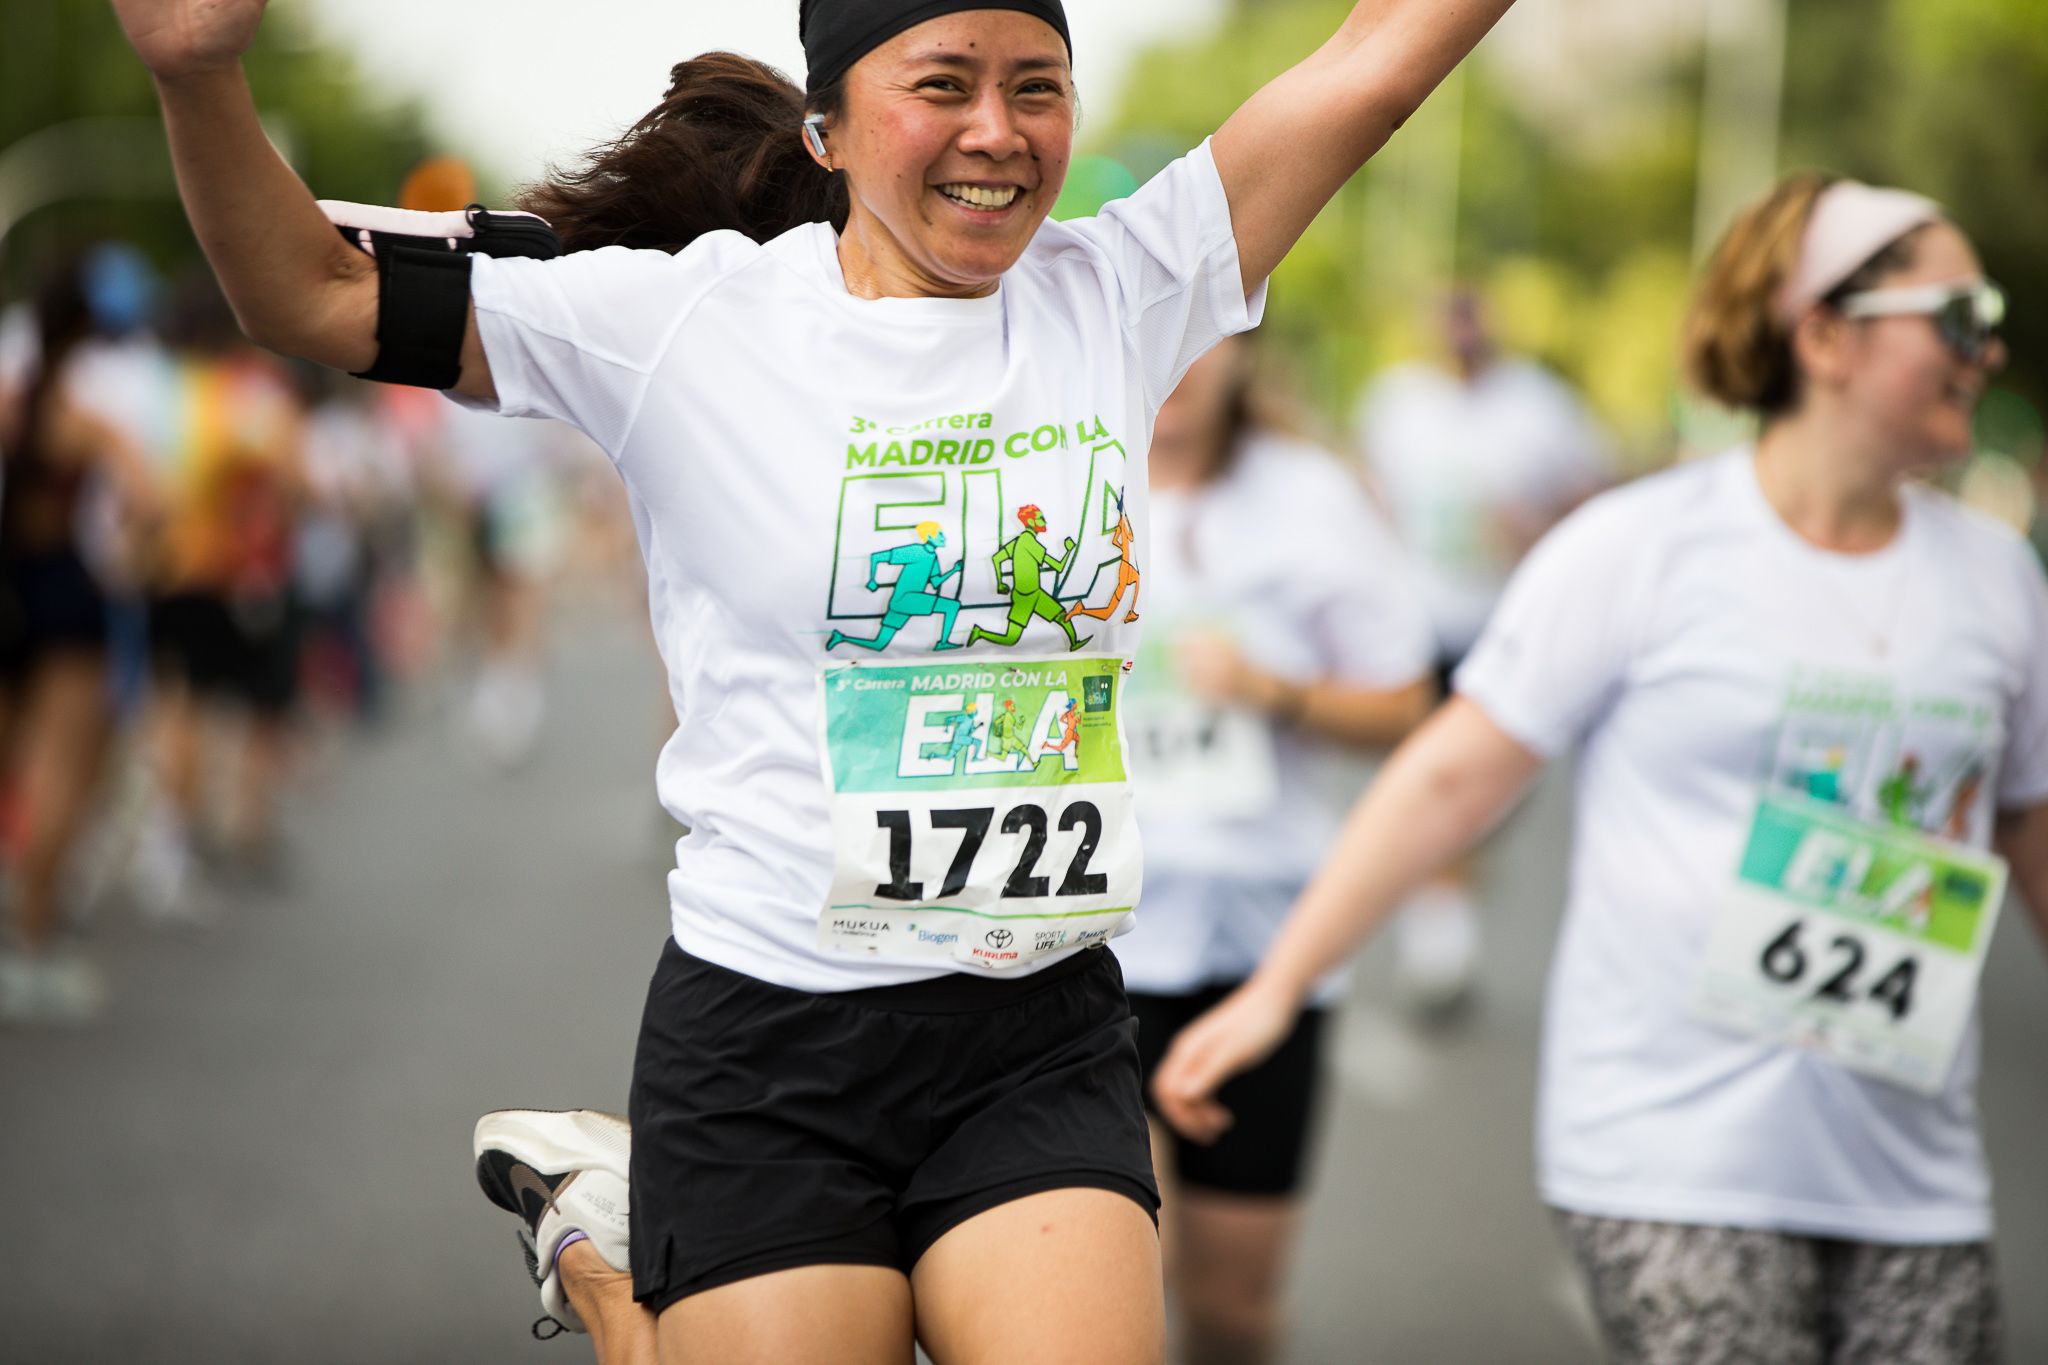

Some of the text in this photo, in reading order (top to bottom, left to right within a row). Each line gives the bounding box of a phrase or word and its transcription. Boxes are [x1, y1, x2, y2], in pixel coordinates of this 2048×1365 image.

[846, 439, 995, 469] MADRID
[826, 439, 1139, 620] ELA
[854, 678, 906, 691] Carrera
[911, 673, 996, 691] MADRID
[1001, 671, 1042, 688] CON
[1045, 671, 1068, 687] LA
[897, 690, 1079, 778] ELA
[874, 801, 1108, 901] 1722
[833, 919, 891, 932] MUKUA
[918, 930, 960, 944] Biogen
[1034, 930, 1061, 941] SPORT
[1035, 940, 1056, 951] LIFE
[1760, 921, 1920, 1020] 624
